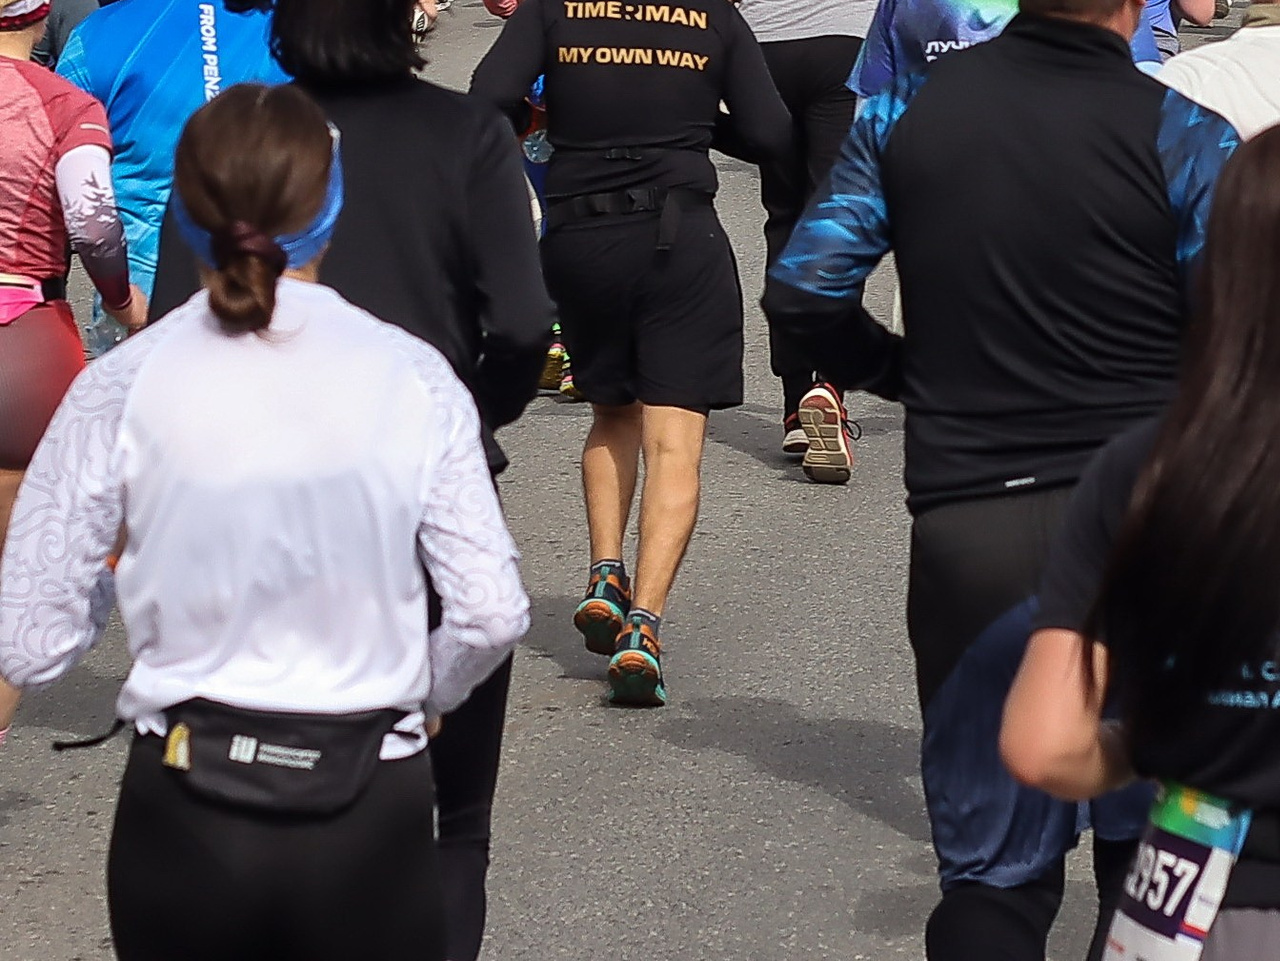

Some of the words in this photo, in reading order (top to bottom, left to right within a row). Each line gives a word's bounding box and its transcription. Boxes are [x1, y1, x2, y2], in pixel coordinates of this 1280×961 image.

[199, 3, 217, 52] FROM
[202, 53, 222, 102] PENZ
[558, 47, 594, 64] MY
[595, 47, 653, 65] OWN
[656, 50, 709, 71] WAY
